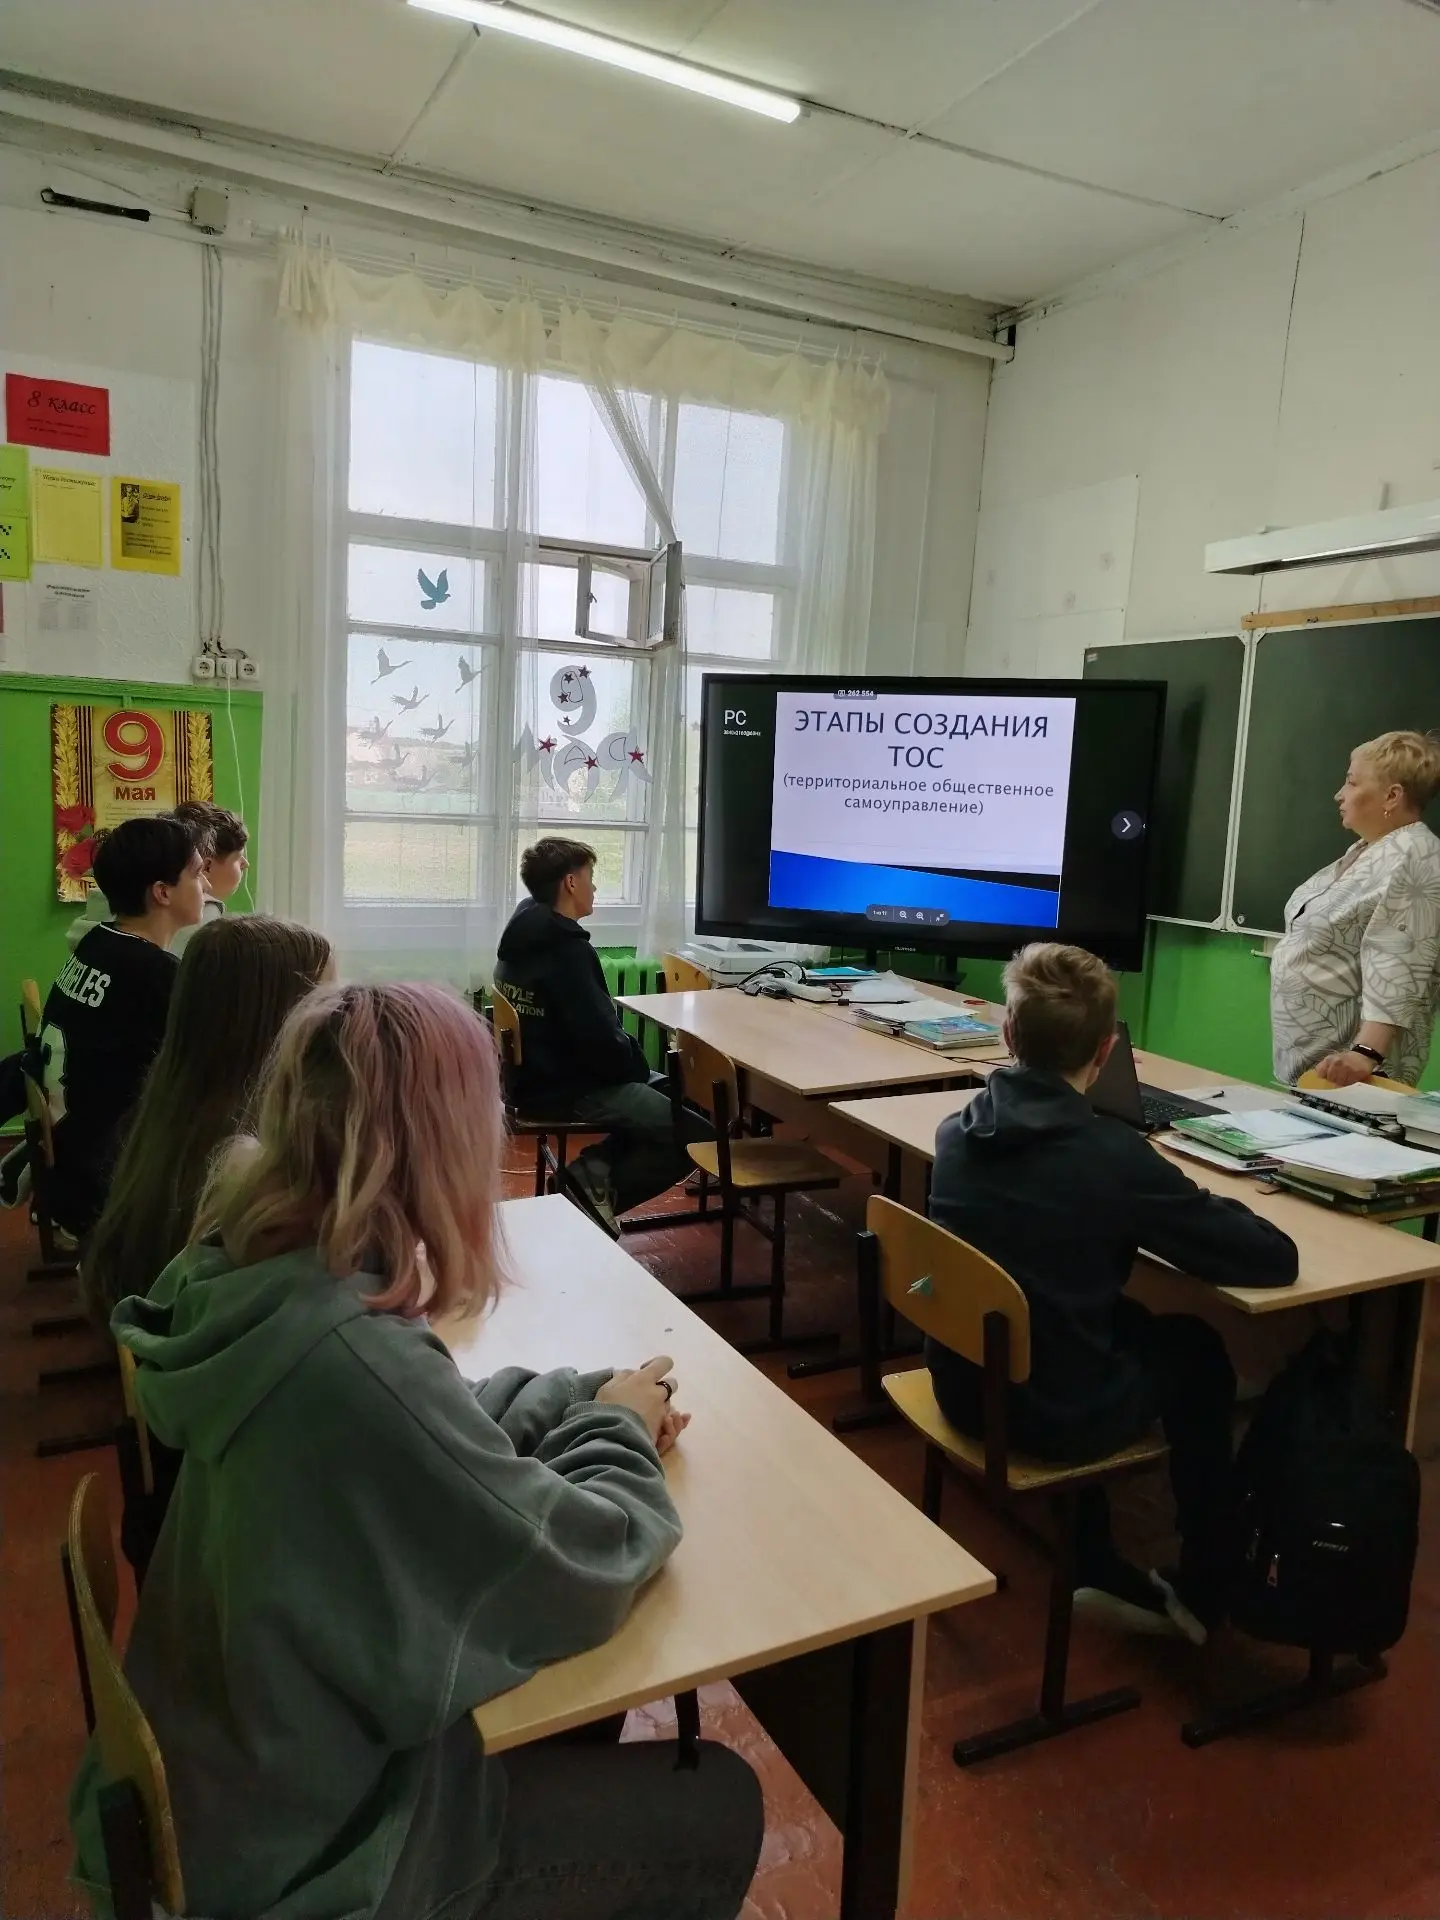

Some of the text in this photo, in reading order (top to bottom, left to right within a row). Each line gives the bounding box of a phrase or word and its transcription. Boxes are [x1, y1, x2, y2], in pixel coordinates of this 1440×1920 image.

[27, 390, 97, 415] 8 класс
[550, 665, 597, 736] 9
[724, 709, 747, 726] PC
[795, 710, 1048, 740] ЭТАПЫ СОЗДАНИЯ
[103, 711, 165, 782] 9
[888, 746, 944, 769] ТОС
[113, 785, 156, 801] мая
[783, 773, 1054, 797] (территориальное общественное
[844, 797, 984, 816] самоуправление)
